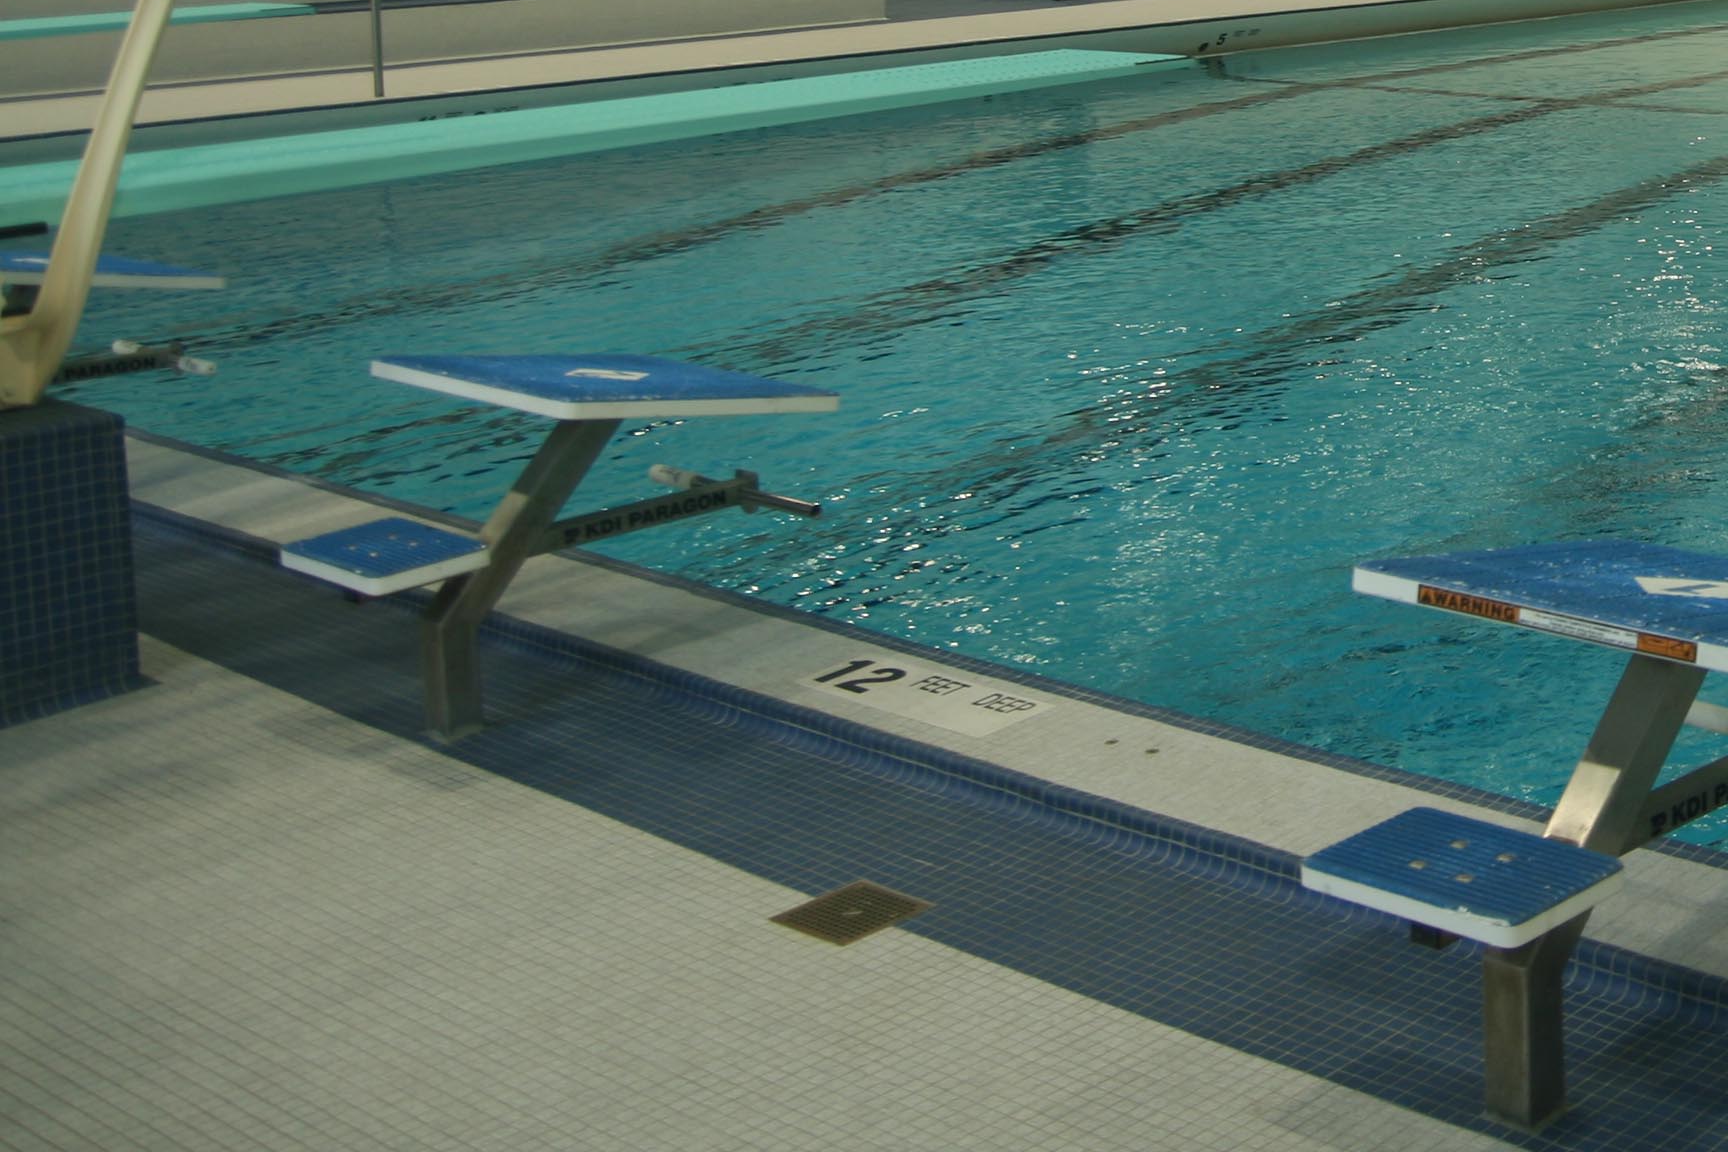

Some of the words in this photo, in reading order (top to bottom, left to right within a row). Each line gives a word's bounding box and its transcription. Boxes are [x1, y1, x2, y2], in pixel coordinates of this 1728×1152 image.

[585, 516, 623, 538] KDI
[629, 489, 727, 528] PARAGON
[1433, 588, 1517, 622] WARNING
[813, 659, 907, 694] 12
[909, 675, 972, 696] FEET
[971, 693, 1037, 714] DEEP
[1671, 791, 1708, 826] KDI
